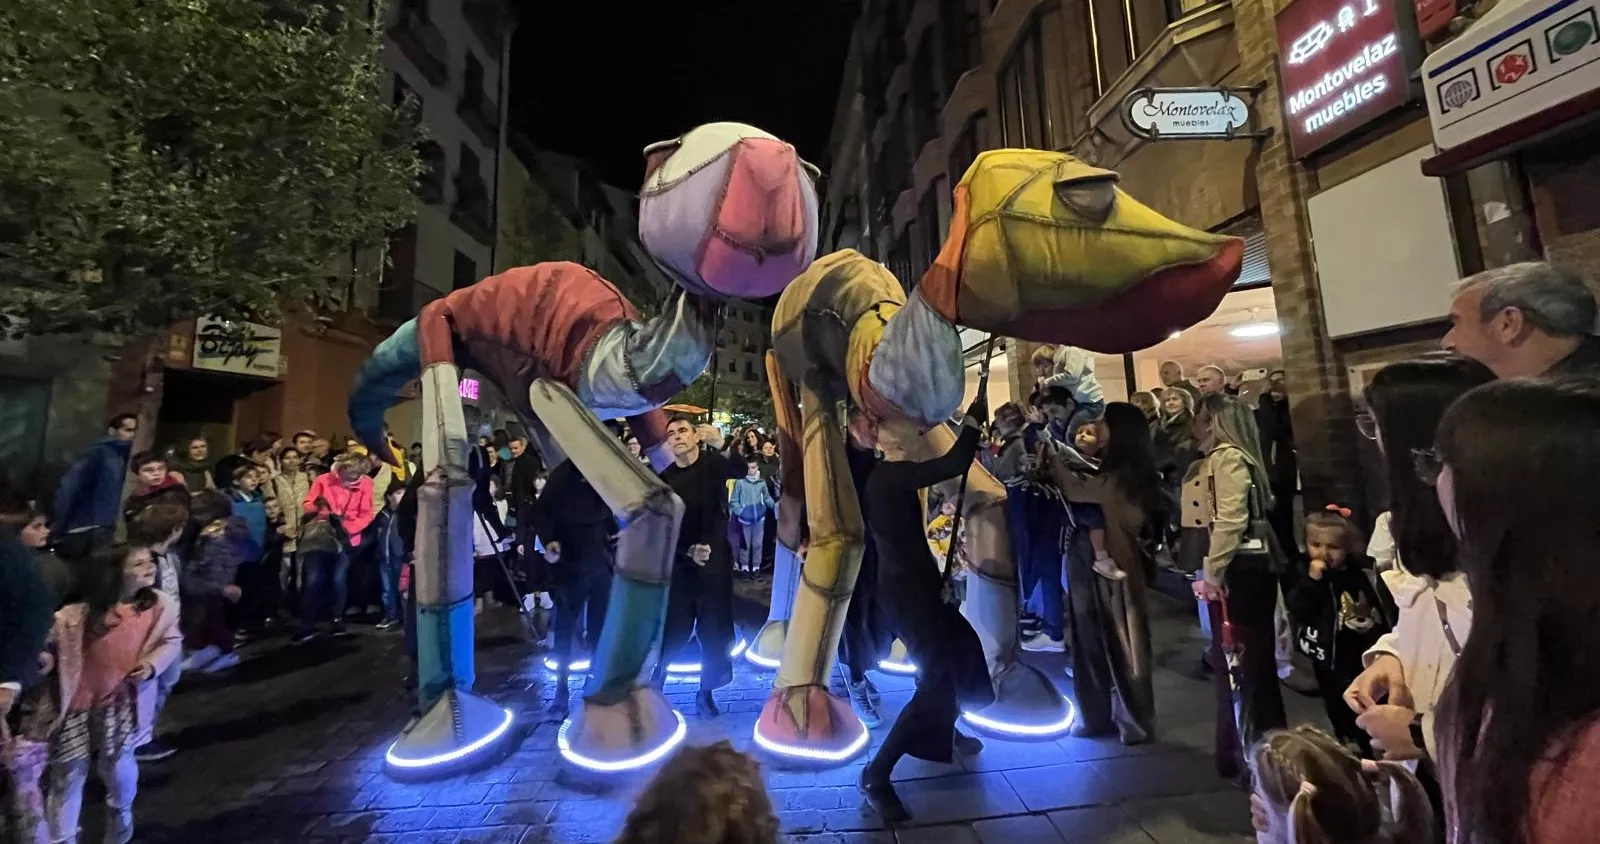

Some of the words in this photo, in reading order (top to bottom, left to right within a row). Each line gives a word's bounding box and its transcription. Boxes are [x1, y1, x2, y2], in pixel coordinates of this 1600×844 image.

[1289, 33, 1398, 114] Montovelaz
[1143, 100, 1238, 121] Montovelaz
[1172, 119, 1209, 127] muebles
[1305, 75, 1387, 133] muebles
